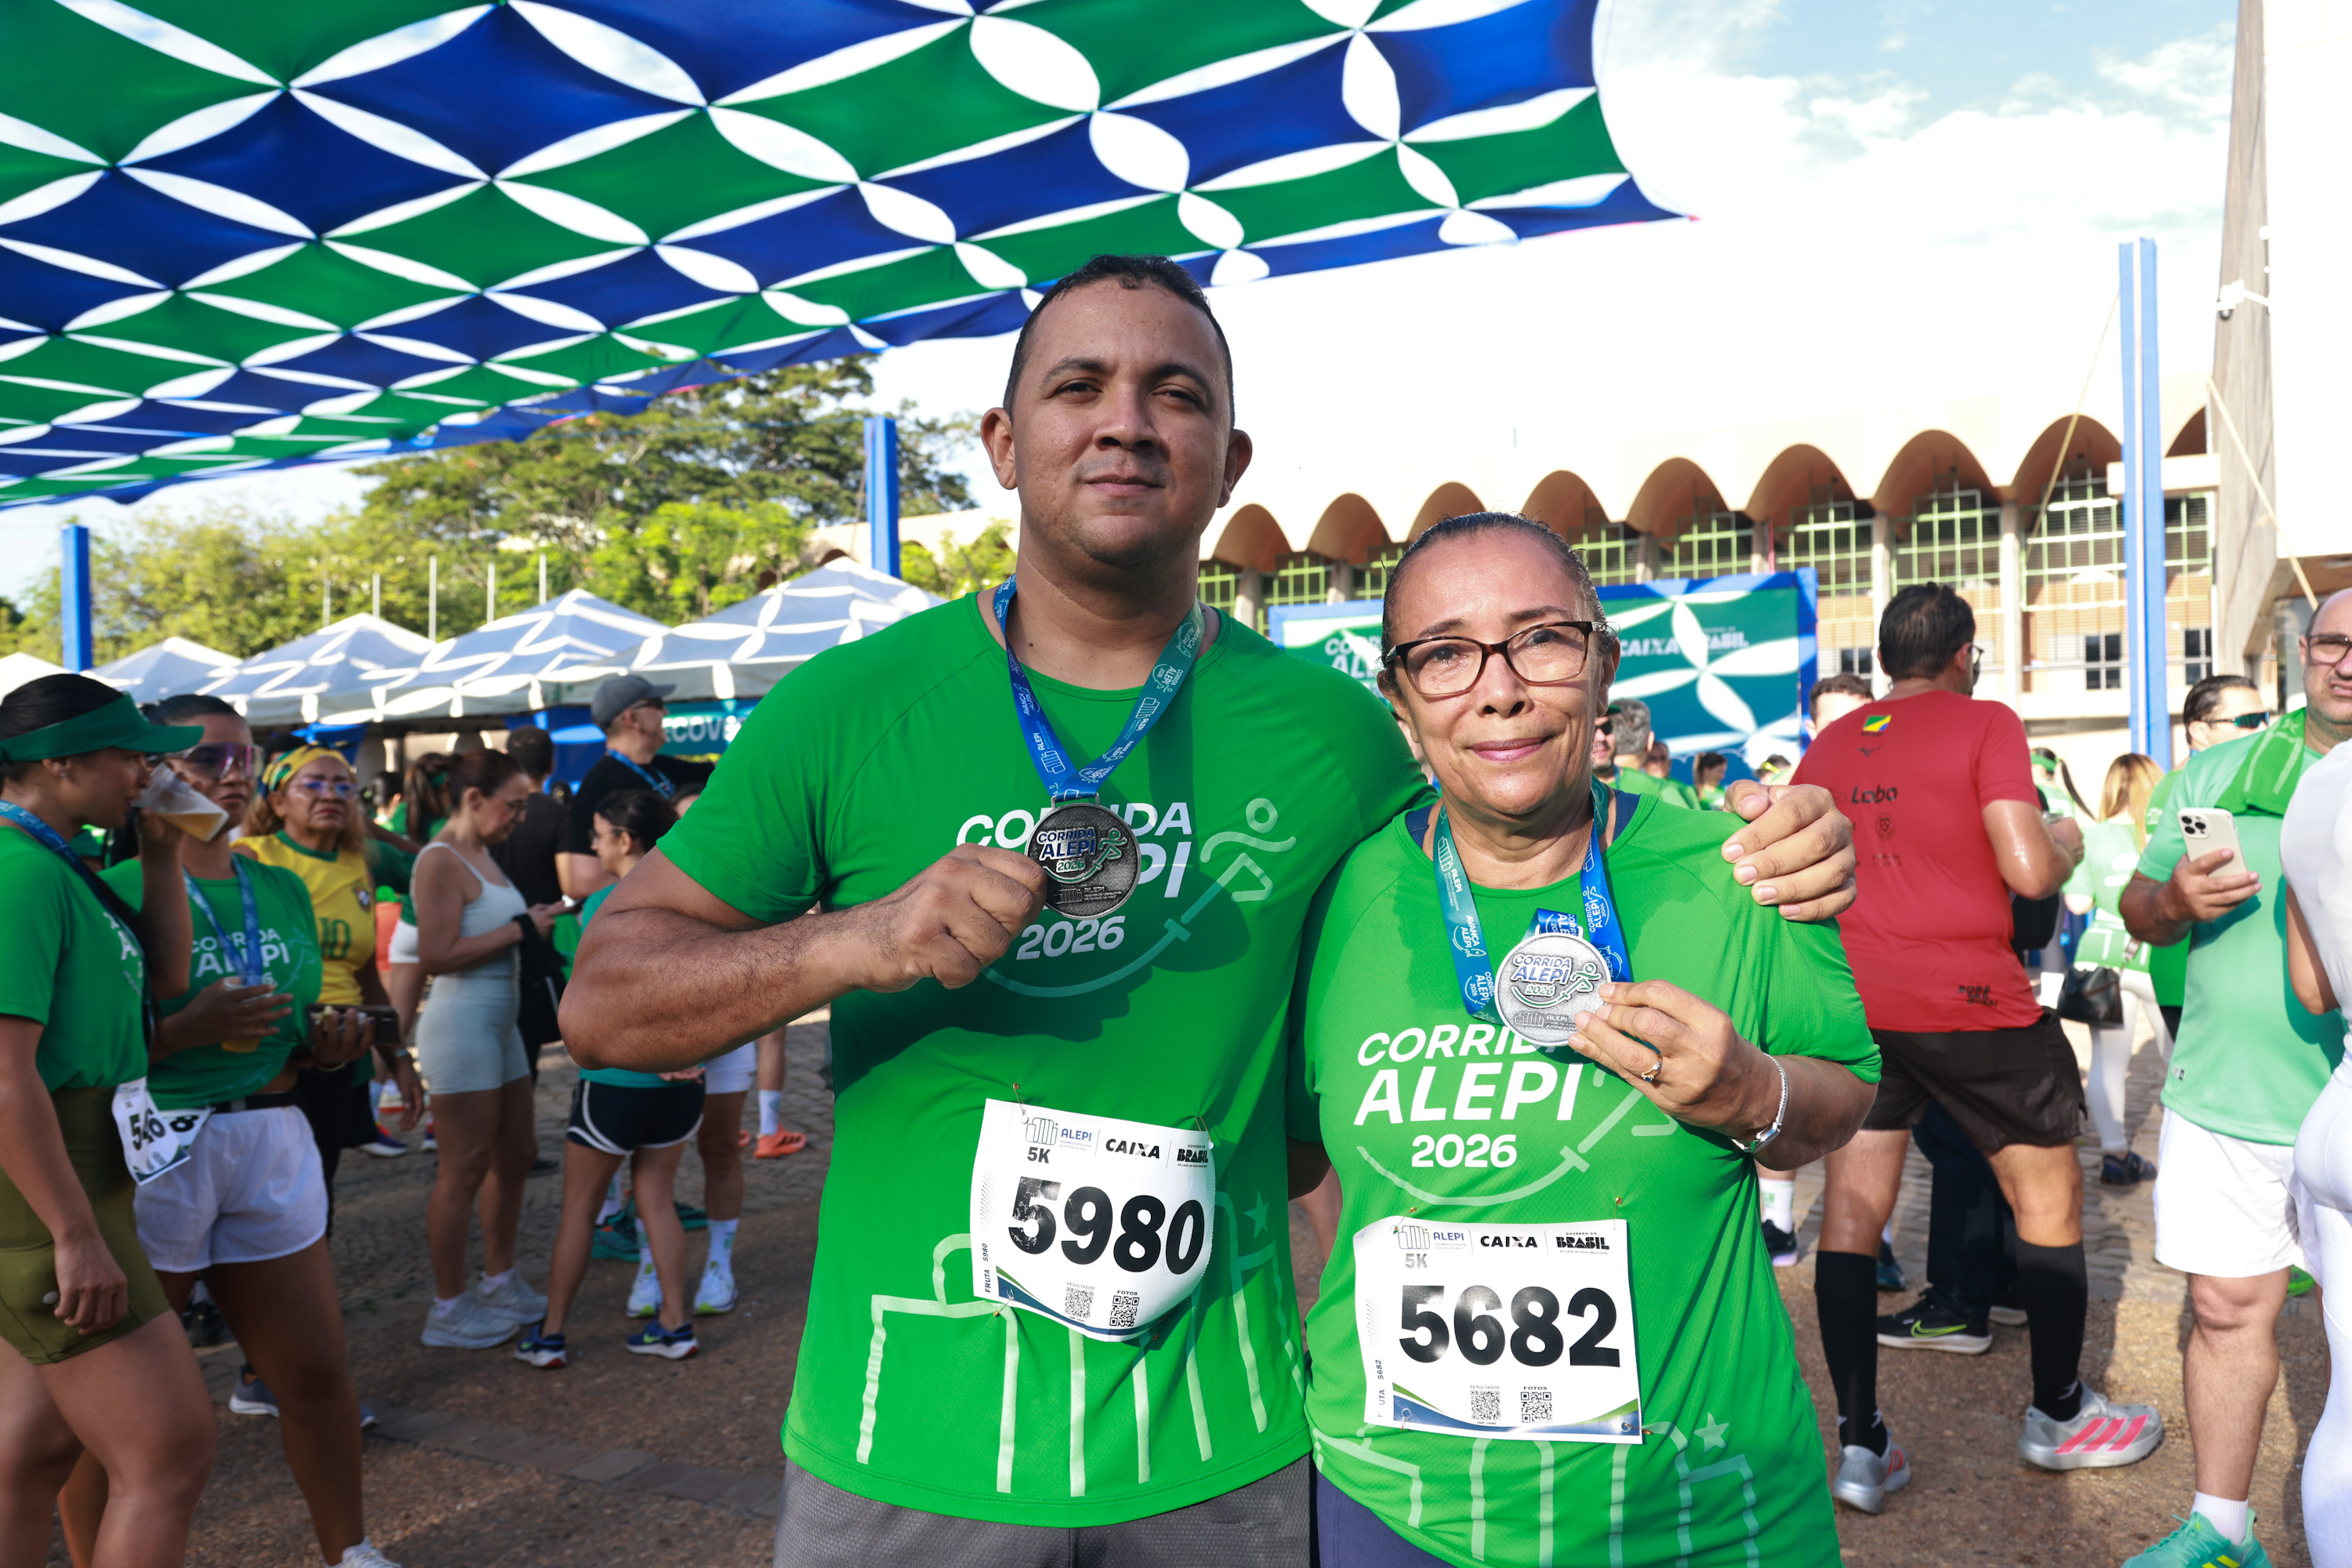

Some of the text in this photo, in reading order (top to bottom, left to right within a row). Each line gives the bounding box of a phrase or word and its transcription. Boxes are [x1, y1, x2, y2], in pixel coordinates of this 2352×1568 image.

[1181, 627, 1194, 645] ALEPI
[1162, 666, 1176, 684] ALEPI
[1033, 732, 1045, 751] ALEPI
[1851, 786, 1897, 804] Lobo
[956, 802, 1192, 849] CODA
[1037, 828, 1095, 844] CORRIDA
[1041, 839, 1096, 859] ALEPI
[1058, 859, 1086, 871] 2026
[1450, 868, 1462, 892] ALEPI
[1585, 902, 1596, 933] CORRIDA
[1590, 898, 1602, 928] ALEPI
[1465, 915, 1480, 946] AVANÇA
[1557, 913, 1570, 934] ALE
[1569, 914, 1577, 936] CORRI
[1016, 916, 1126, 960] 2026
[1461, 927, 1472, 948] ALEPI
[1514, 954, 1571, 969] CORRIDA
[1512, 966, 1570, 983] ALEPI
[1475, 975, 1490, 1001] ALEPI
[1526, 985, 1554, 996] 2026
[1357, 1024, 1552, 1067] CORRI
[1353, 1061, 1584, 1126] ALEPI
[1061, 1128, 1092, 1142] ALEPI
[1027, 1147, 1051, 1164] 5K
[1105, 1138, 1160, 1159] CAIXA
[1177, 1149, 1208, 1163] BRASIL
[1411, 1133, 1518, 1168] 2026
[1008, 1176, 1205, 1275] 5980
[1433, 1232, 1465, 1241] ALEPI
[1480, 1236, 1538, 1248] CAIXA
[1556, 1236, 1610, 1250] BRASIL
[1405, 1254, 1428, 1269] 5K
[1066, 1282, 1095, 1290] RESULTADOS
[1399, 1285, 1621, 1368] 5682
[1375, 1359, 1384, 1380] 5682
